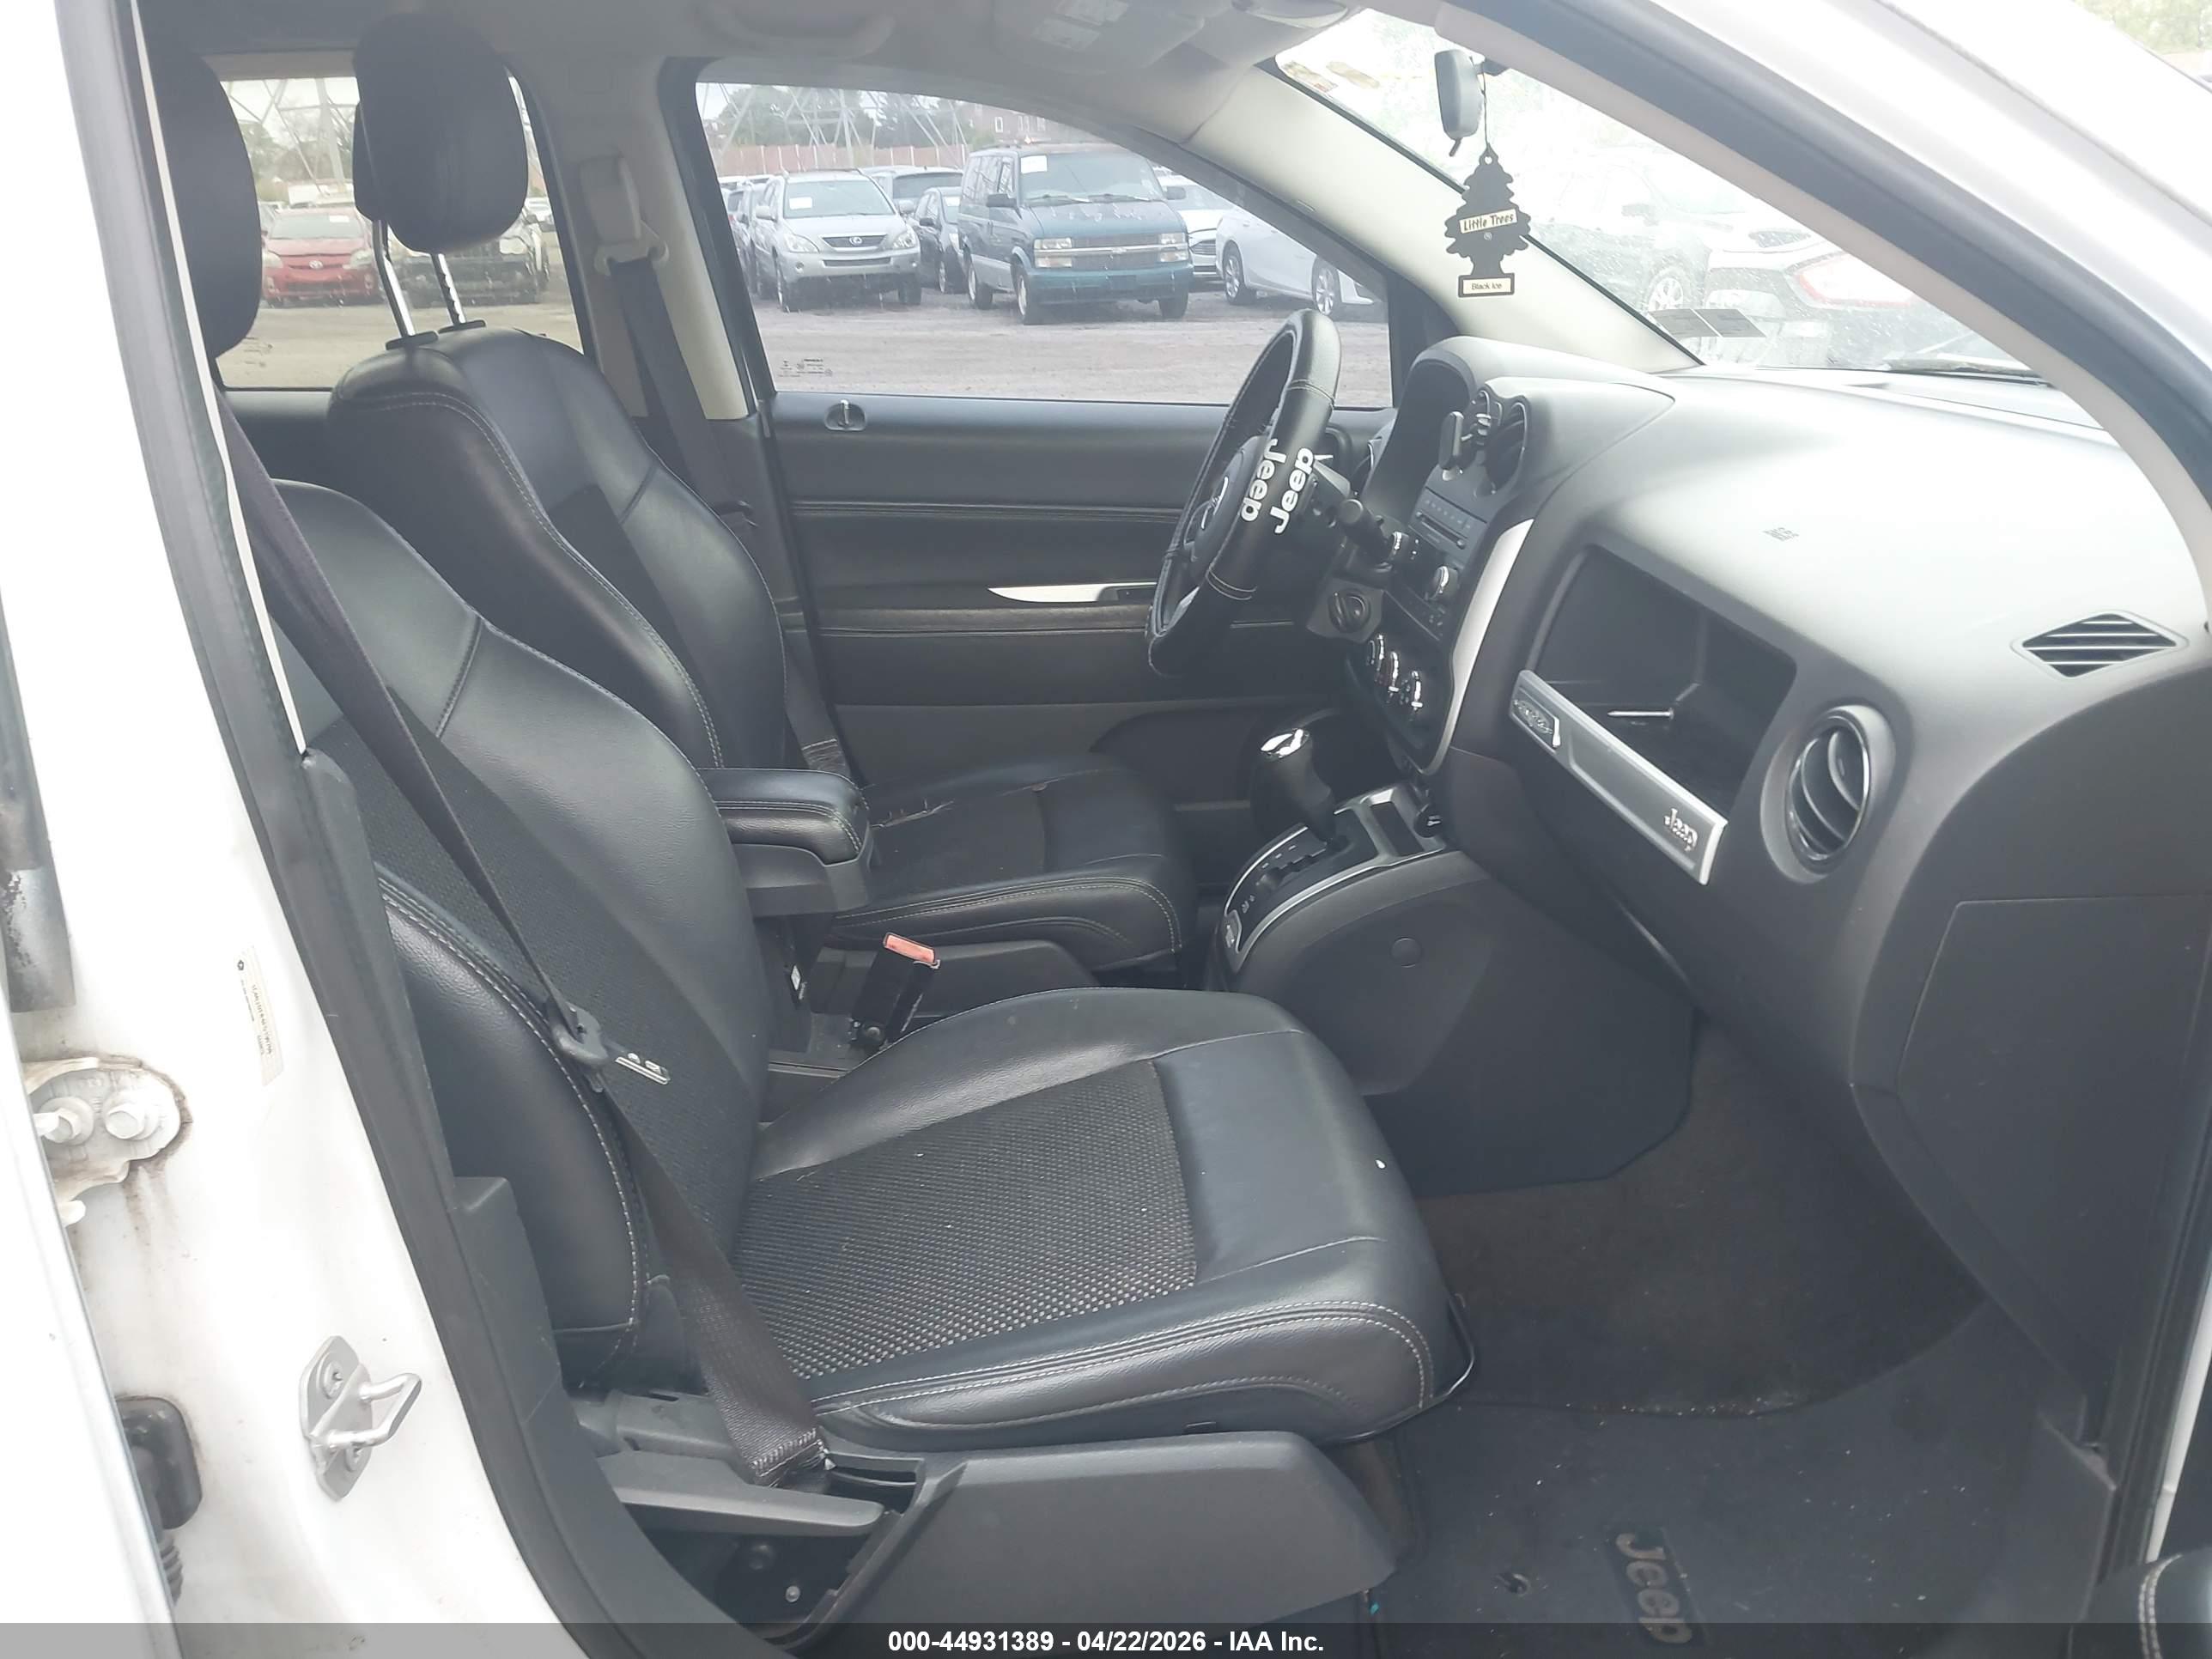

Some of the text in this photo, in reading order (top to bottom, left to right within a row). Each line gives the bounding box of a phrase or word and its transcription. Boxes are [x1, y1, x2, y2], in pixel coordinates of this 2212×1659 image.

[1463, 214, 1514, 231] Little Trees
[1241, 438, 1287, 522] Jeep
[1269, 447, 1314, 534] Jeep
[1615, 1532, 1692, 1644] Jeep
